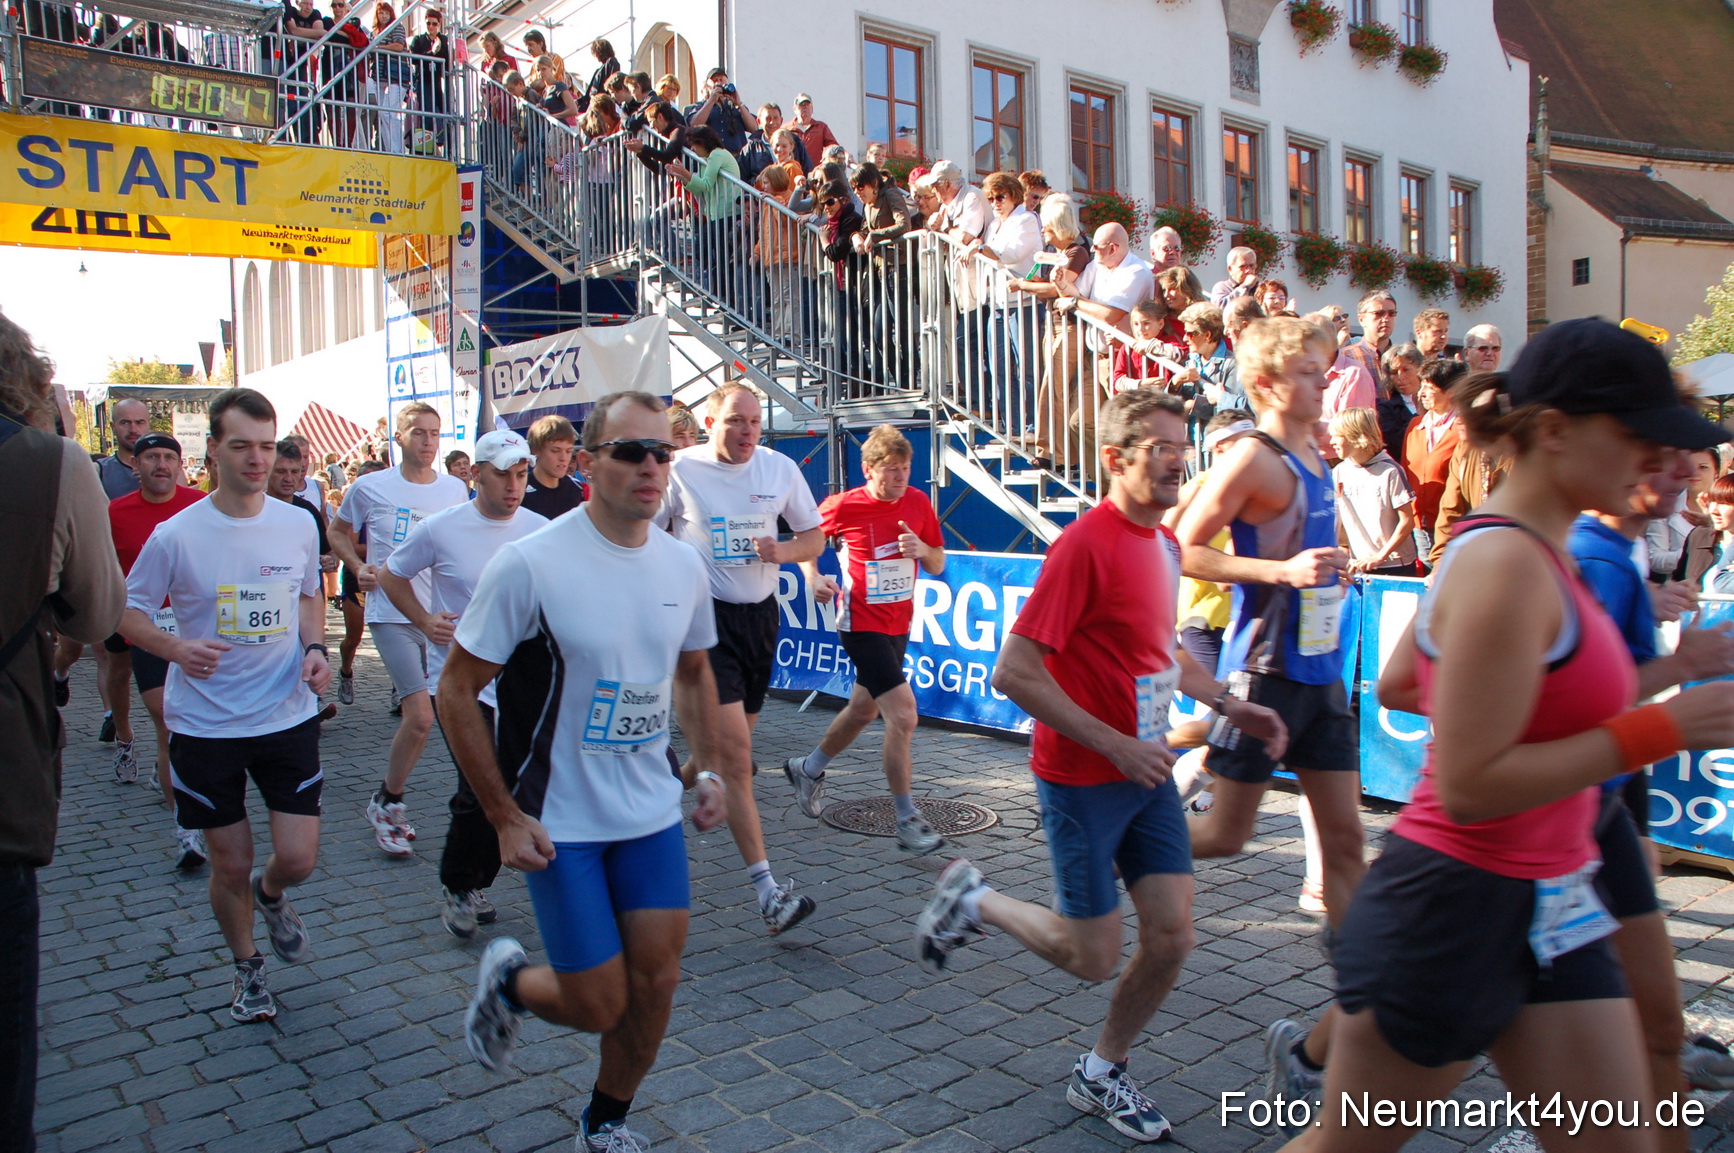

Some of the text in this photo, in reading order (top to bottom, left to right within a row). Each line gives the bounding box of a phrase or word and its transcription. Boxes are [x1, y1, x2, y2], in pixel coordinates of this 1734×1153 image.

[110, 56, 167, 72] Elektronische
[151, 75, 270, 121] 10:00:47
[16, 134, 259, 206] START
[299, 190, 426, 210] Neumarkter Stadtlauf
[241, 227, 352, 245] Neumarkter Stadtlauf
[883, 576, 911, 592] 2537
[239, 590, 267, 601] Marc
[248, 609, 281, 628] 861
[621, 689, 660, 705] Stefan
[615, 709, 667, 737] 3200
